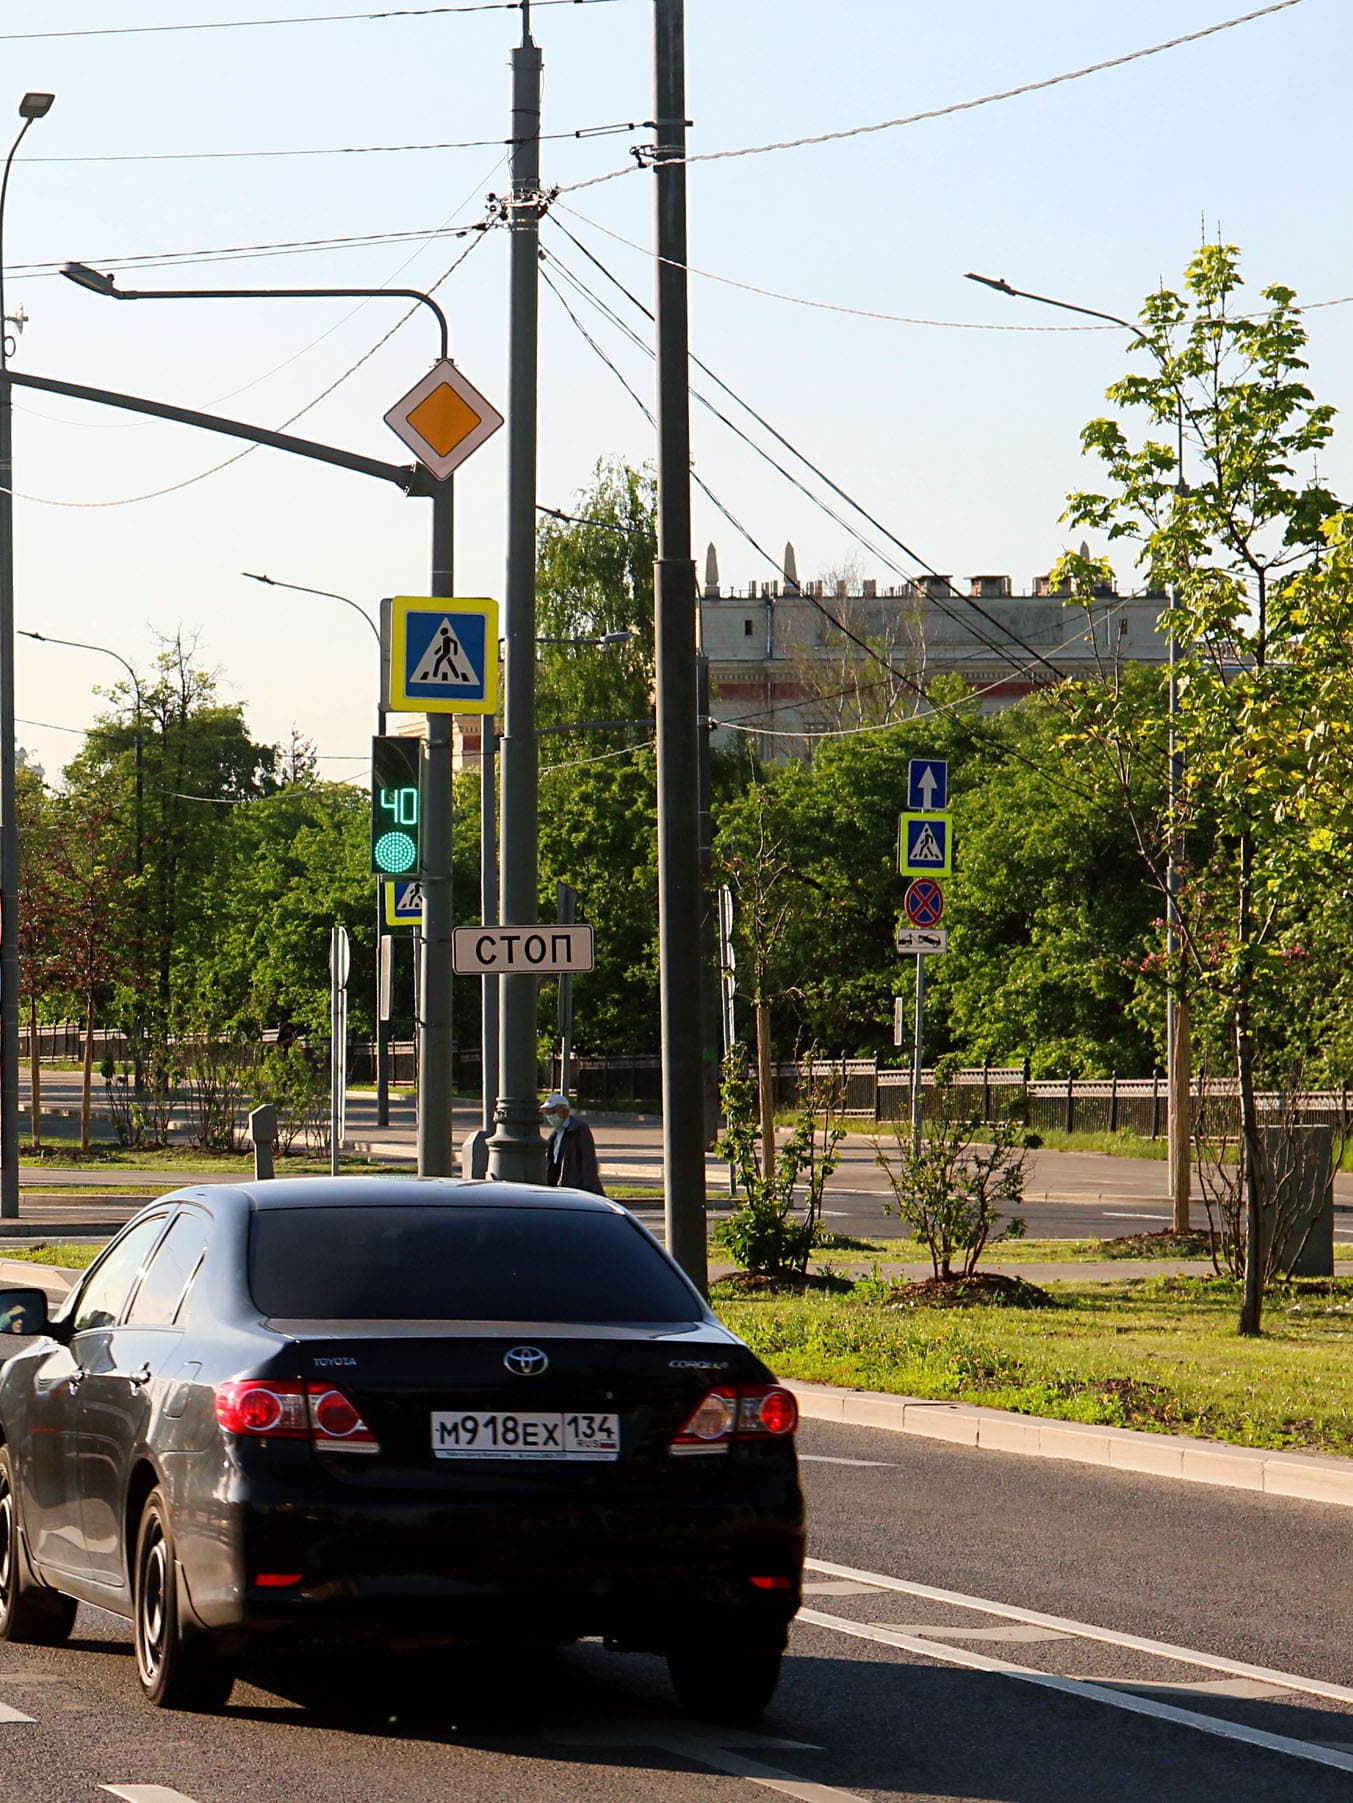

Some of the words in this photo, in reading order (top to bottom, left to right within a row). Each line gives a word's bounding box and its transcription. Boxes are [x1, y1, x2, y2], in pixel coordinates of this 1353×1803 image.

[381, 788, 417, 825] 40
[475, 934, 572, 965] СТОП
[312, 1357, 358, 1367] TOYOTA
[576, 1439, 598, 1448] RUS
